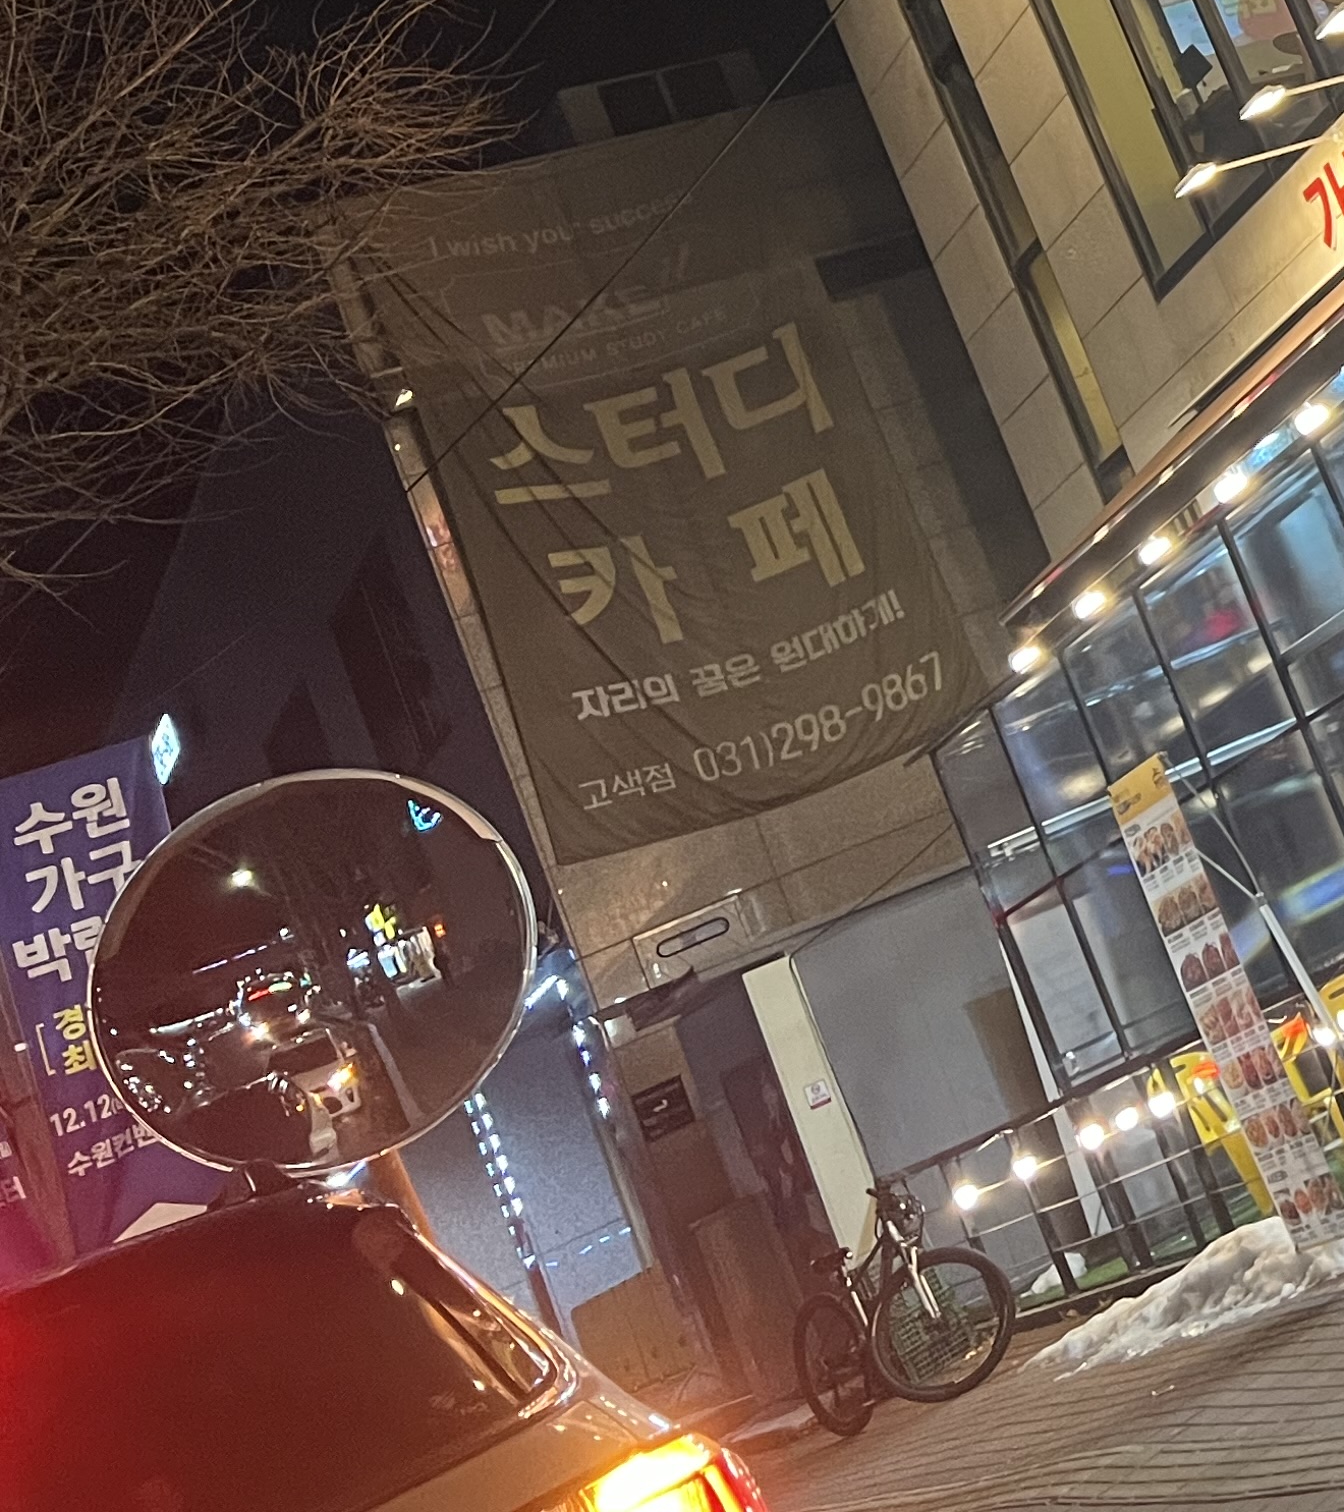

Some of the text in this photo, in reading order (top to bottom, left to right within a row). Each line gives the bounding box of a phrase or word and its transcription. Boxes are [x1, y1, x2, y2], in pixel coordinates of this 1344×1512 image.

[490, 321, 834, 505] 스터디
[572, 589, 905, 720] 자리의 꿈은 원대하게!
[578, 651, 943, 810] 고색점 031)298-9867
[14, 777, 131, 854] 수원
[25, 840, 142, 913] 가구
